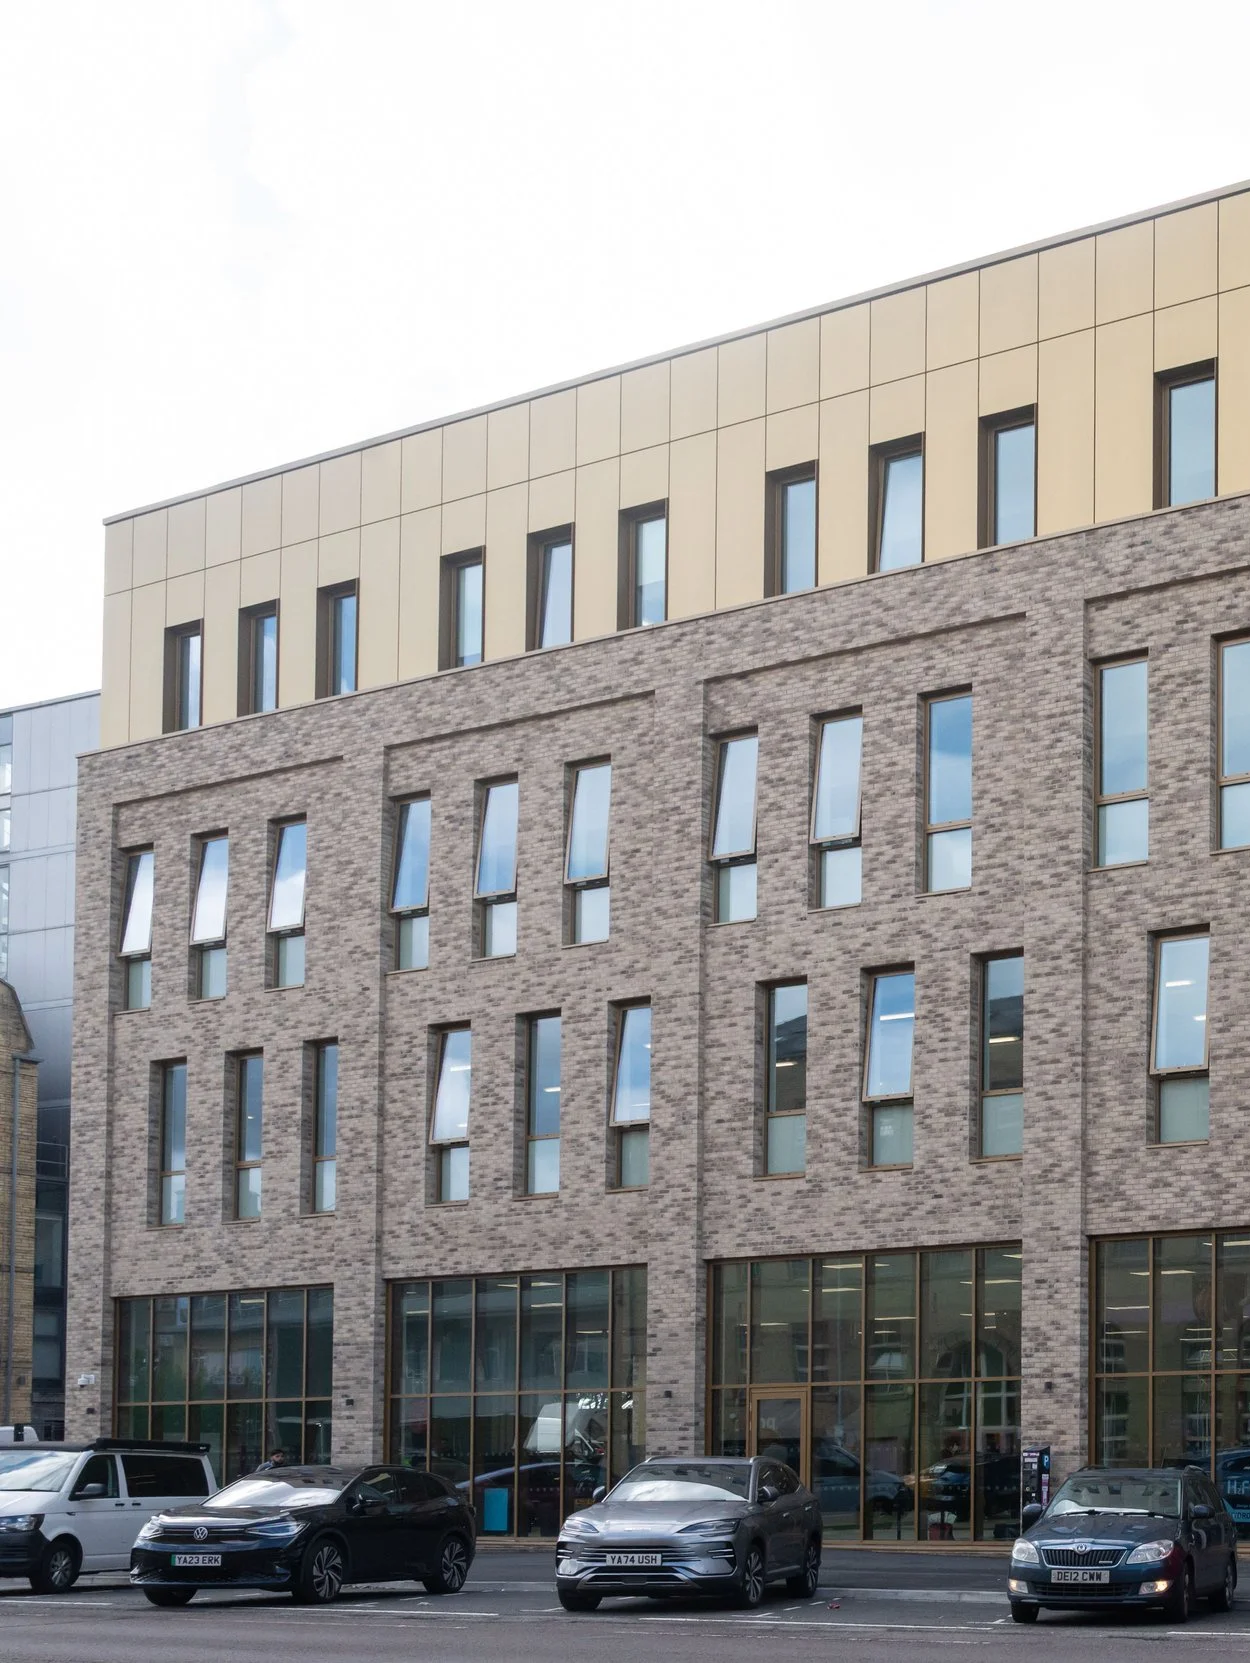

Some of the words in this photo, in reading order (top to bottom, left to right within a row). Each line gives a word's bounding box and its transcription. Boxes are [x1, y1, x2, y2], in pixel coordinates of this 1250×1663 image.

[177, 1555, 200, 1565] YA23
[201, 1555, 220, 1565] ERK
[610, 1555, 635, 1565] YA74
[637, 1555, 657, 1565] USH
[1057, 1571, 1079, 1581] DE12
